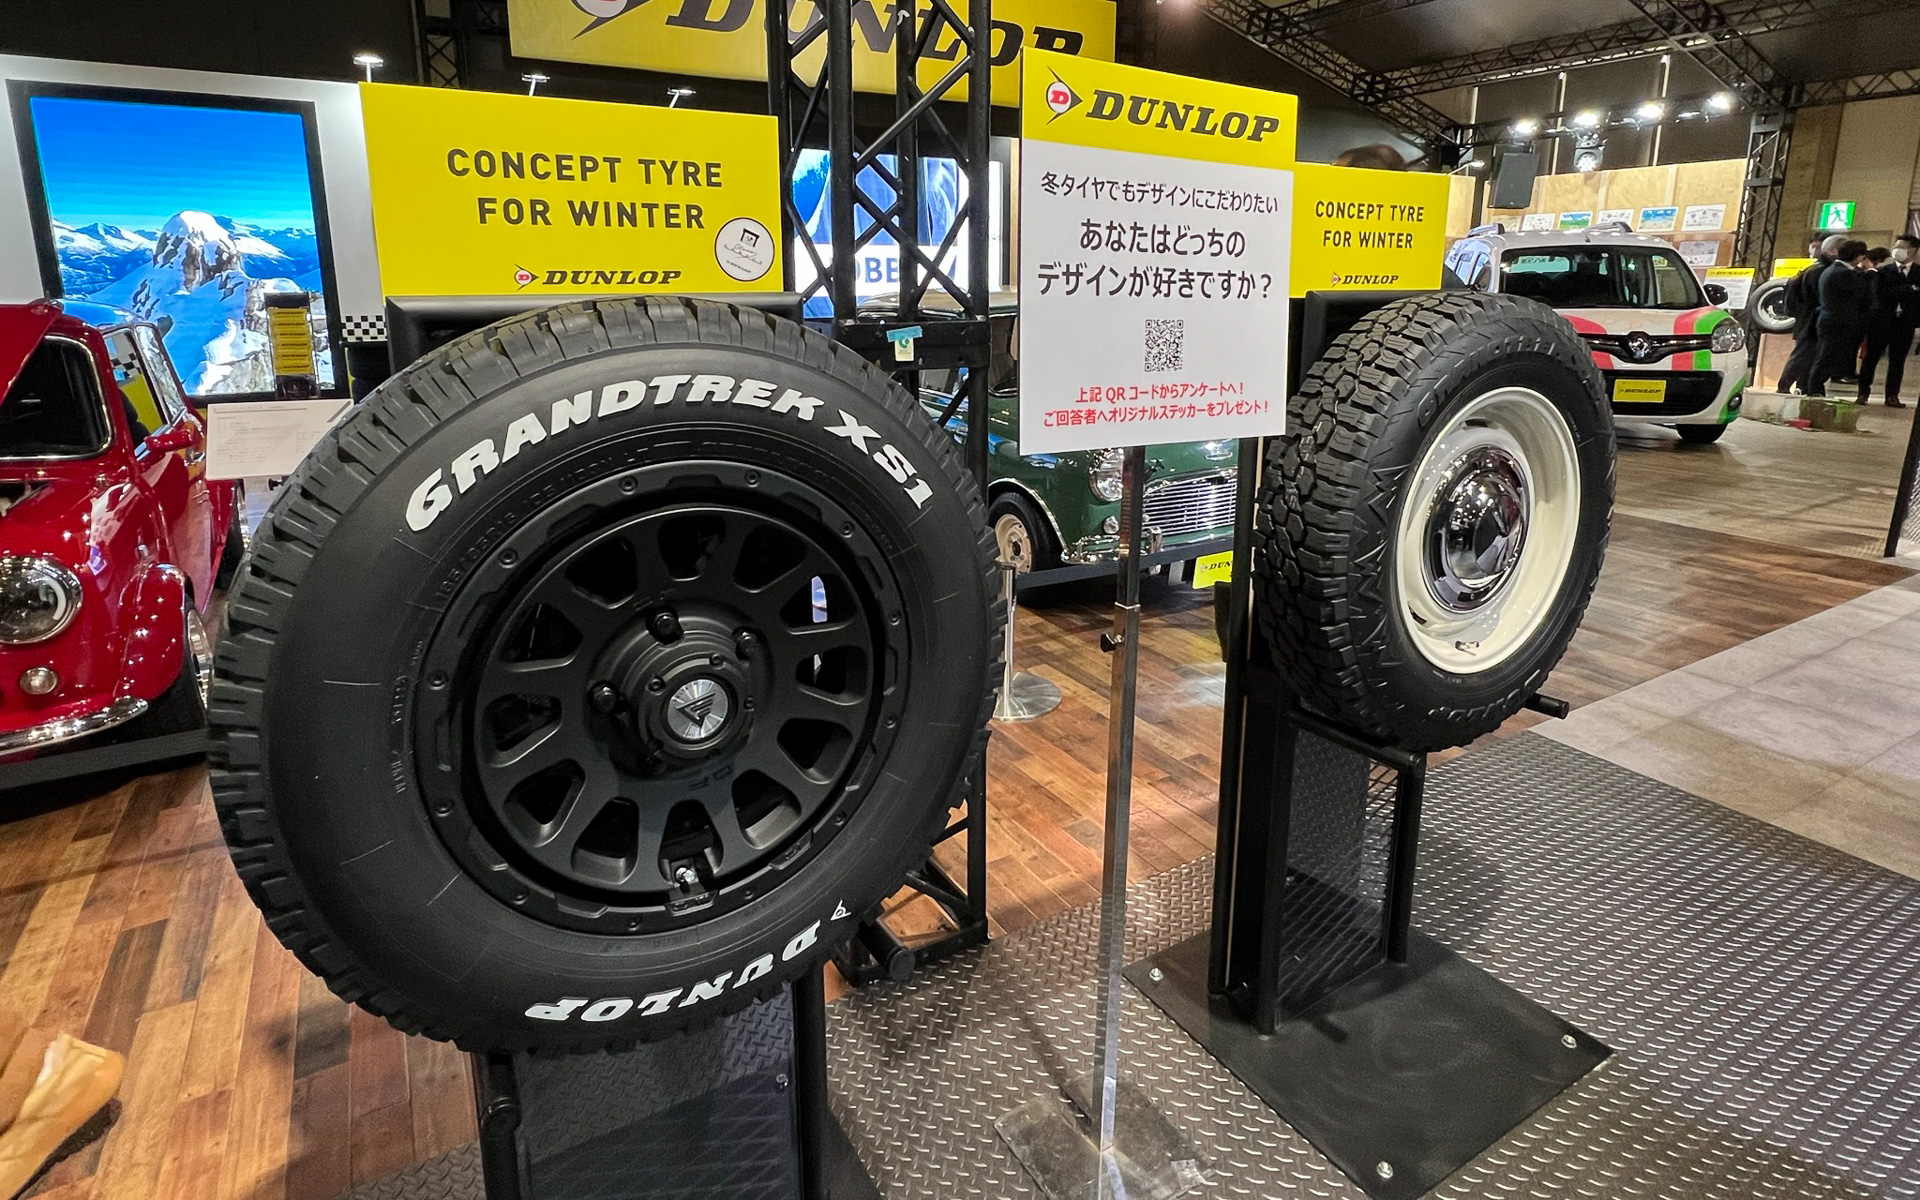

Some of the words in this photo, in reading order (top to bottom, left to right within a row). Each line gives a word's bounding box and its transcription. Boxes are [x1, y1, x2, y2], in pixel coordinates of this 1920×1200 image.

[1085, 89, 1280, 142] DUNLOP
[447, 148, 622, 183] CONCEPT
[638, 158, 723, 188] TYRE
[1041, 171, 1278, 214] 冬タイヤでもデザインにこだわりたい
[1315, 200, 1384, 221] CONCEPT
[1390, 204, 1424, 222] TYRE
[477, 197, 553, 226] FOR
[567, 200, 705, 229] WINTER
[1080, 218, 1246, 258] あなたはどっちの
[1322, 230, 1352, 248] FOR
[1359, 231, 1413, 249] WINTER
[542, 270, 682, 286] DUNLOP
[1037, 261, 1273, 300] デザインが好きですか？
[1341, 275, 1400, 285] DUNLOP
[1075, 387, 1102, 403] 上記
[1105, 387, 1126, 404] QR
[404, 374, 826, 533] GRANDTREK
[823, 408, 935, 510] XS1
[524, 919, 821, 1022] DUNLOP
